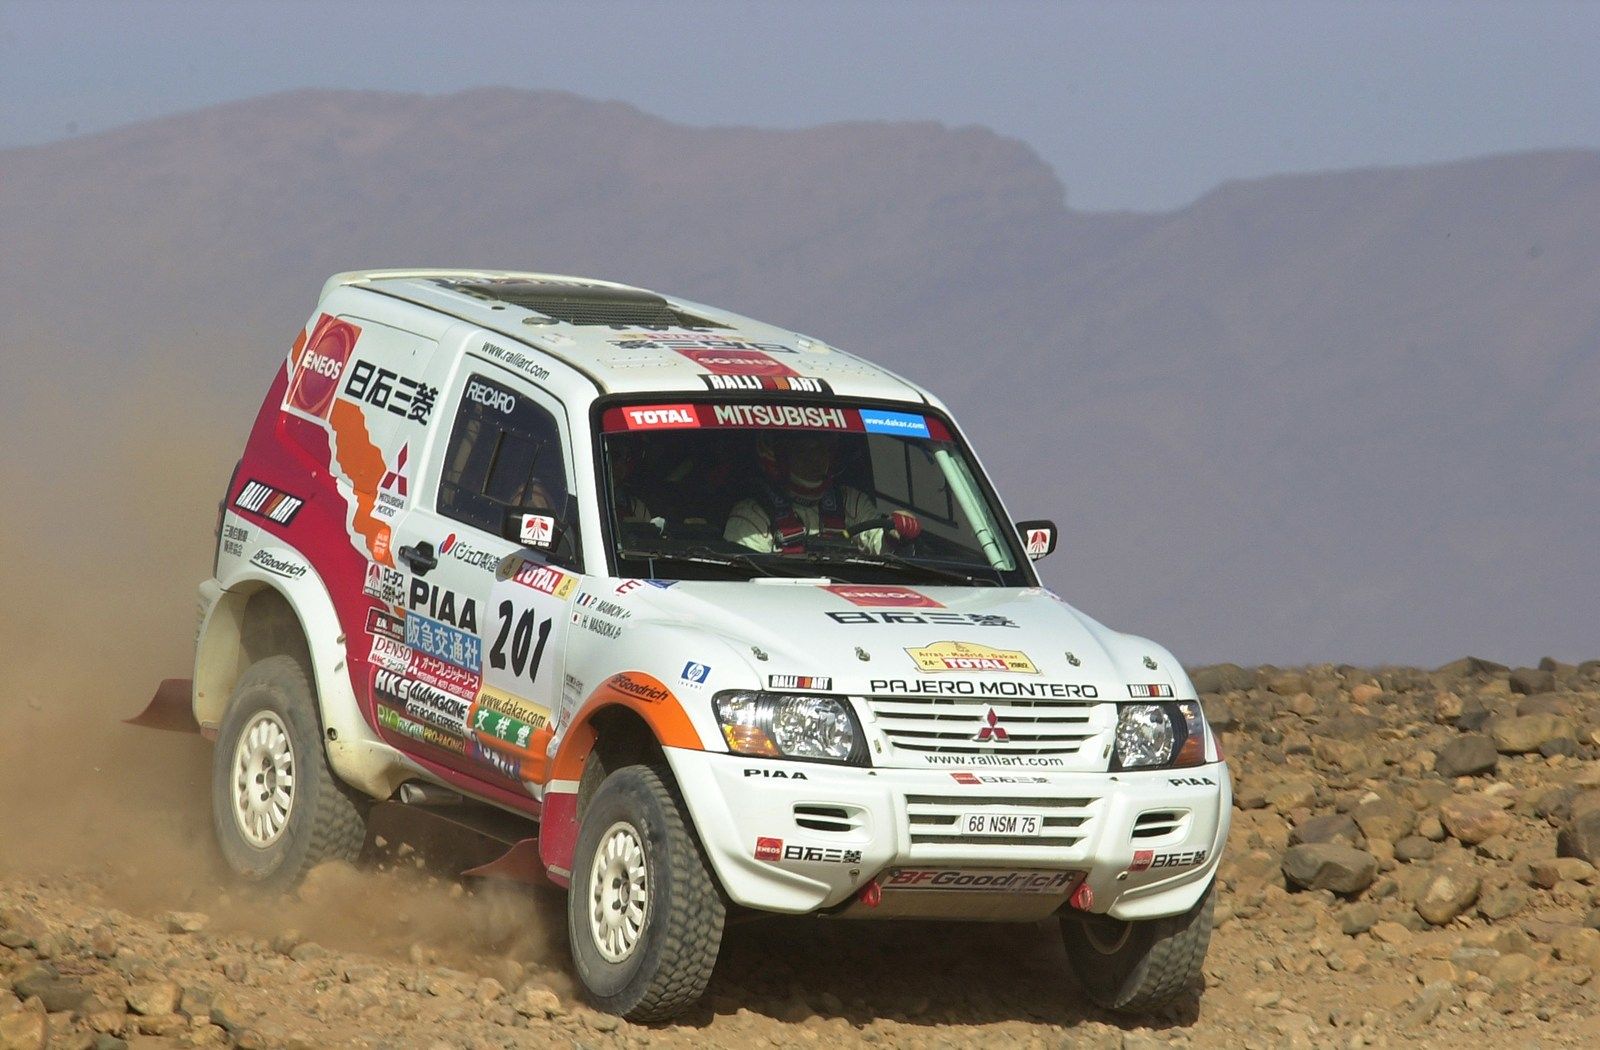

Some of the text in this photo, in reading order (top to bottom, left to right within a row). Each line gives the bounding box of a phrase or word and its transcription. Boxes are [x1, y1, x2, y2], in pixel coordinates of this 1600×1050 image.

[302, 350, 343, 380] ENEOS
[481, 340, 550, 381] www.ralliart.com
[344, 359, 439, 427] 日石三菱
[708, 375, 822, 392] RALLI ART
[466, 381, 515, 414] RECARO
[630, 409, 693, 425] TOTAL
[713, 404, 847, 428] MITSUBISHI
[864, 416, 925, 430] www.dakar.com
[235, 481, 303, 524] RALLI ART
[253, 549, 307, 577] BFGoodrich
[515, 561, 560, 593] TOTAL
[409, 577, 478, 635] PIAA
[375, 637, 412, 662] DENSO
[406, 614, 480, 670] 阪急交通社
[489, 599, 552, 684] 201
[943, 659, 1007, 669] TOTAL
[374, 668, 412, 700] HKS
[611, 674, 669, 702] BFGoodrich
[772, 675, 830, 690] RALLI ART
[870, 679, 1098, 698] PAJERO MONTERO
[480, 693, 547, 729] www.dakar.com
[925, 752, 1064, 767] www.ralliart.com
[743, 769, 809, 781] PIAA
[1167, 777, 1217, 787] PIAA
[968, 815, 1036, 833] 68 NSM 75
[784, 845, 863, 864] 日石三菱
[889, 870, 1071, 888] BFGoodrich
